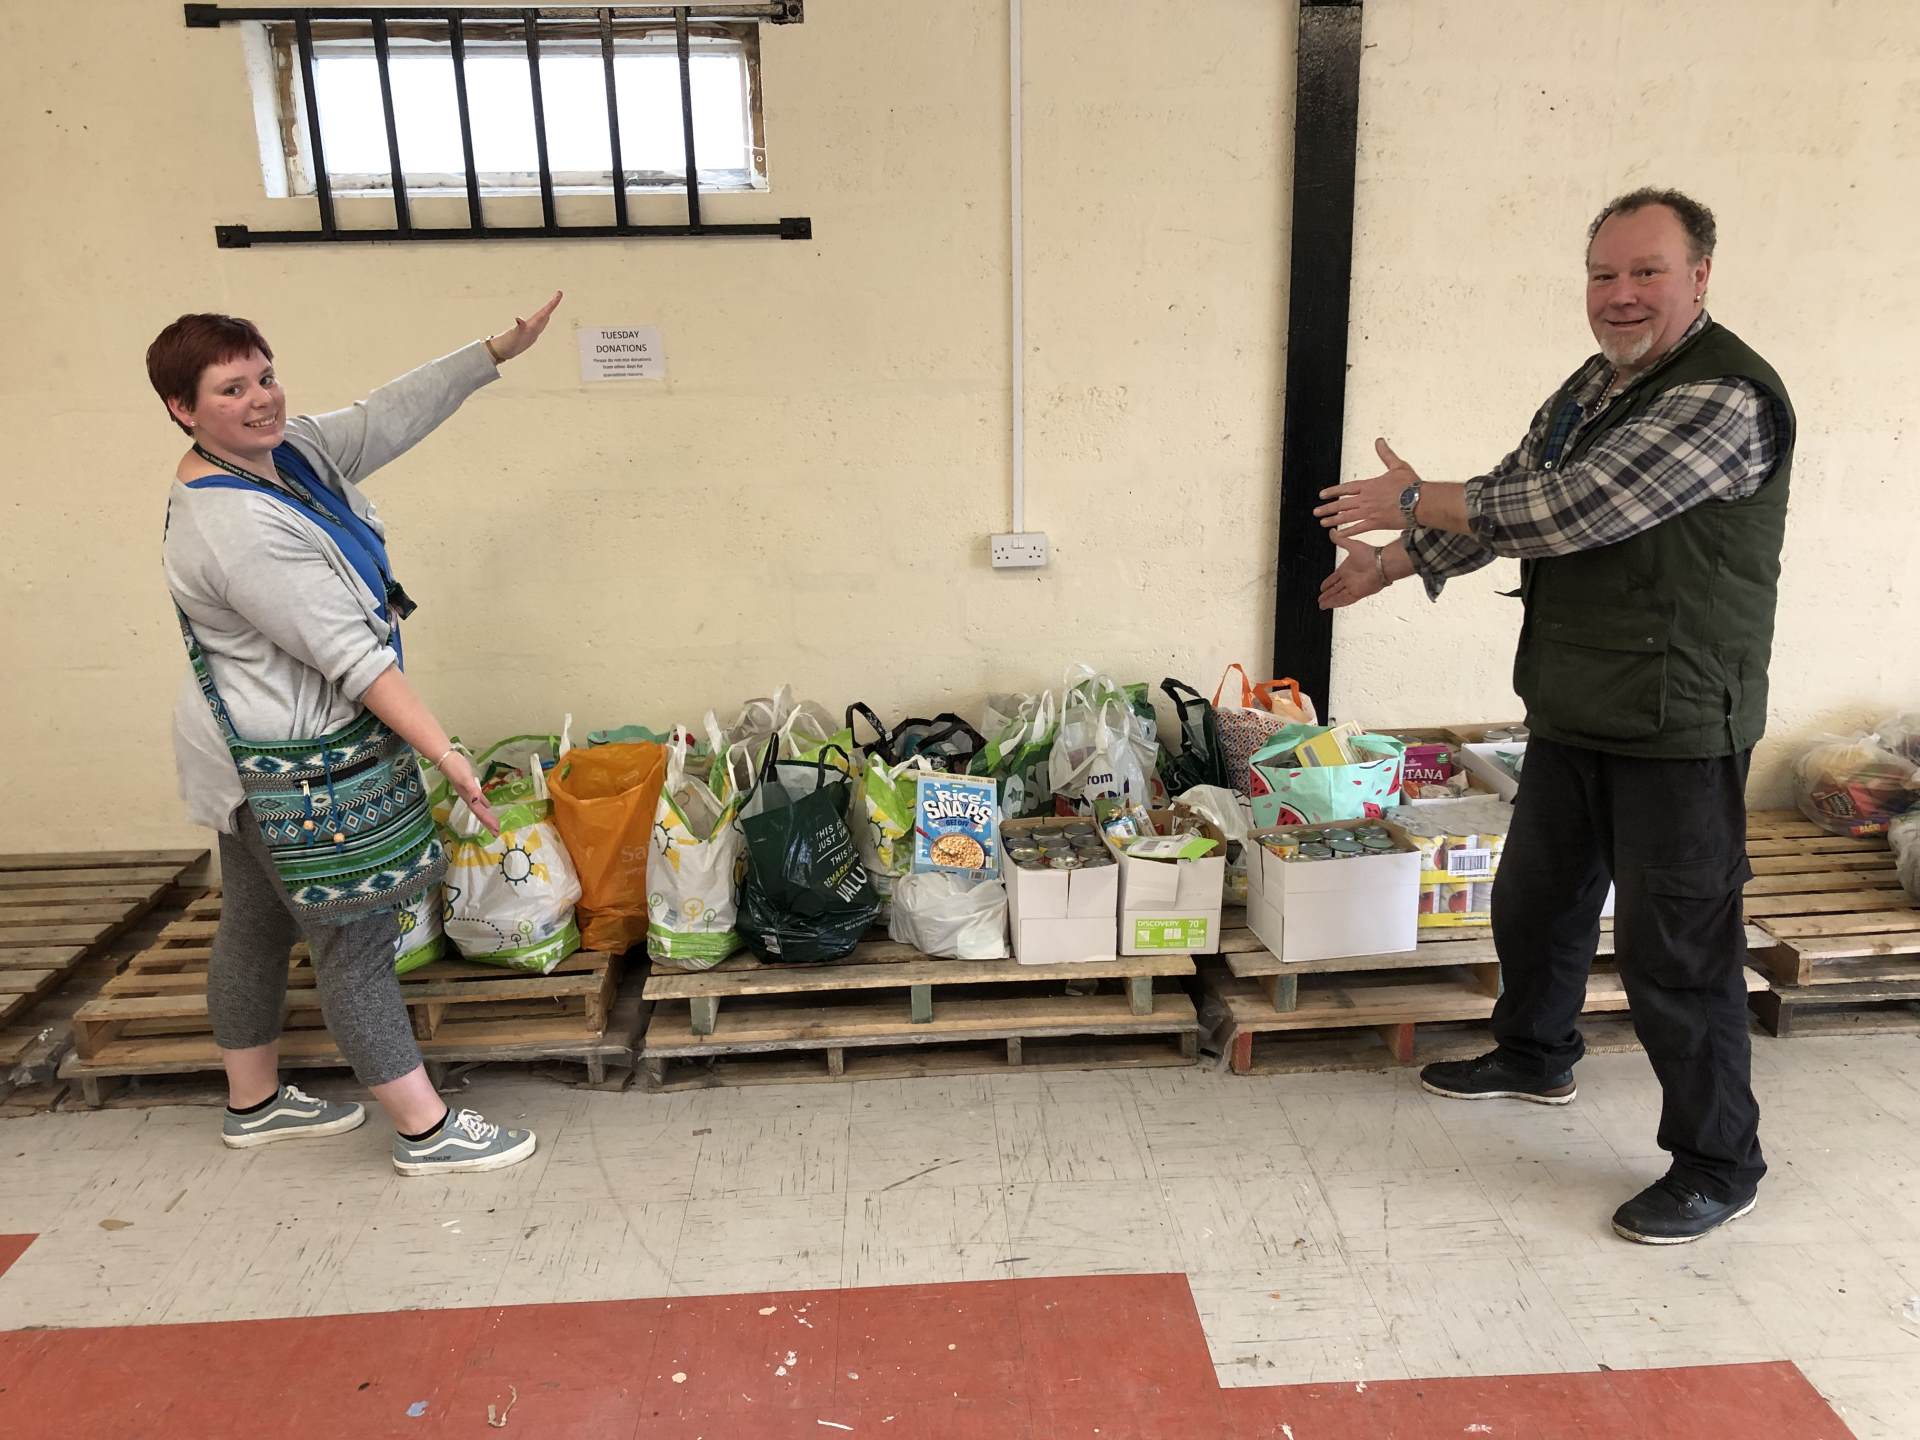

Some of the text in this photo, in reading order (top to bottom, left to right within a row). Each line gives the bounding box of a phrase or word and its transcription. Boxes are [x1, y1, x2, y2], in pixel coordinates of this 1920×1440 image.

[601, 331, 639, 339] TUESDAY
[596, 344, 647, 353] DONATIONS
[1087, 773, 1113, 785] rom
[1404, 769, 1443, 780] TANA
[935, 788, 982, 806] Rice
[922, 799, 993, 826] SNAPS
[815, 824, 834, 840] THIS
[818, 833, 836, 853] JUST
[830, 849, 848, 867] THIS
[835, 862, 868, 903] VALU
[1137, 919, 1200, 929] DISCOVERY 70
